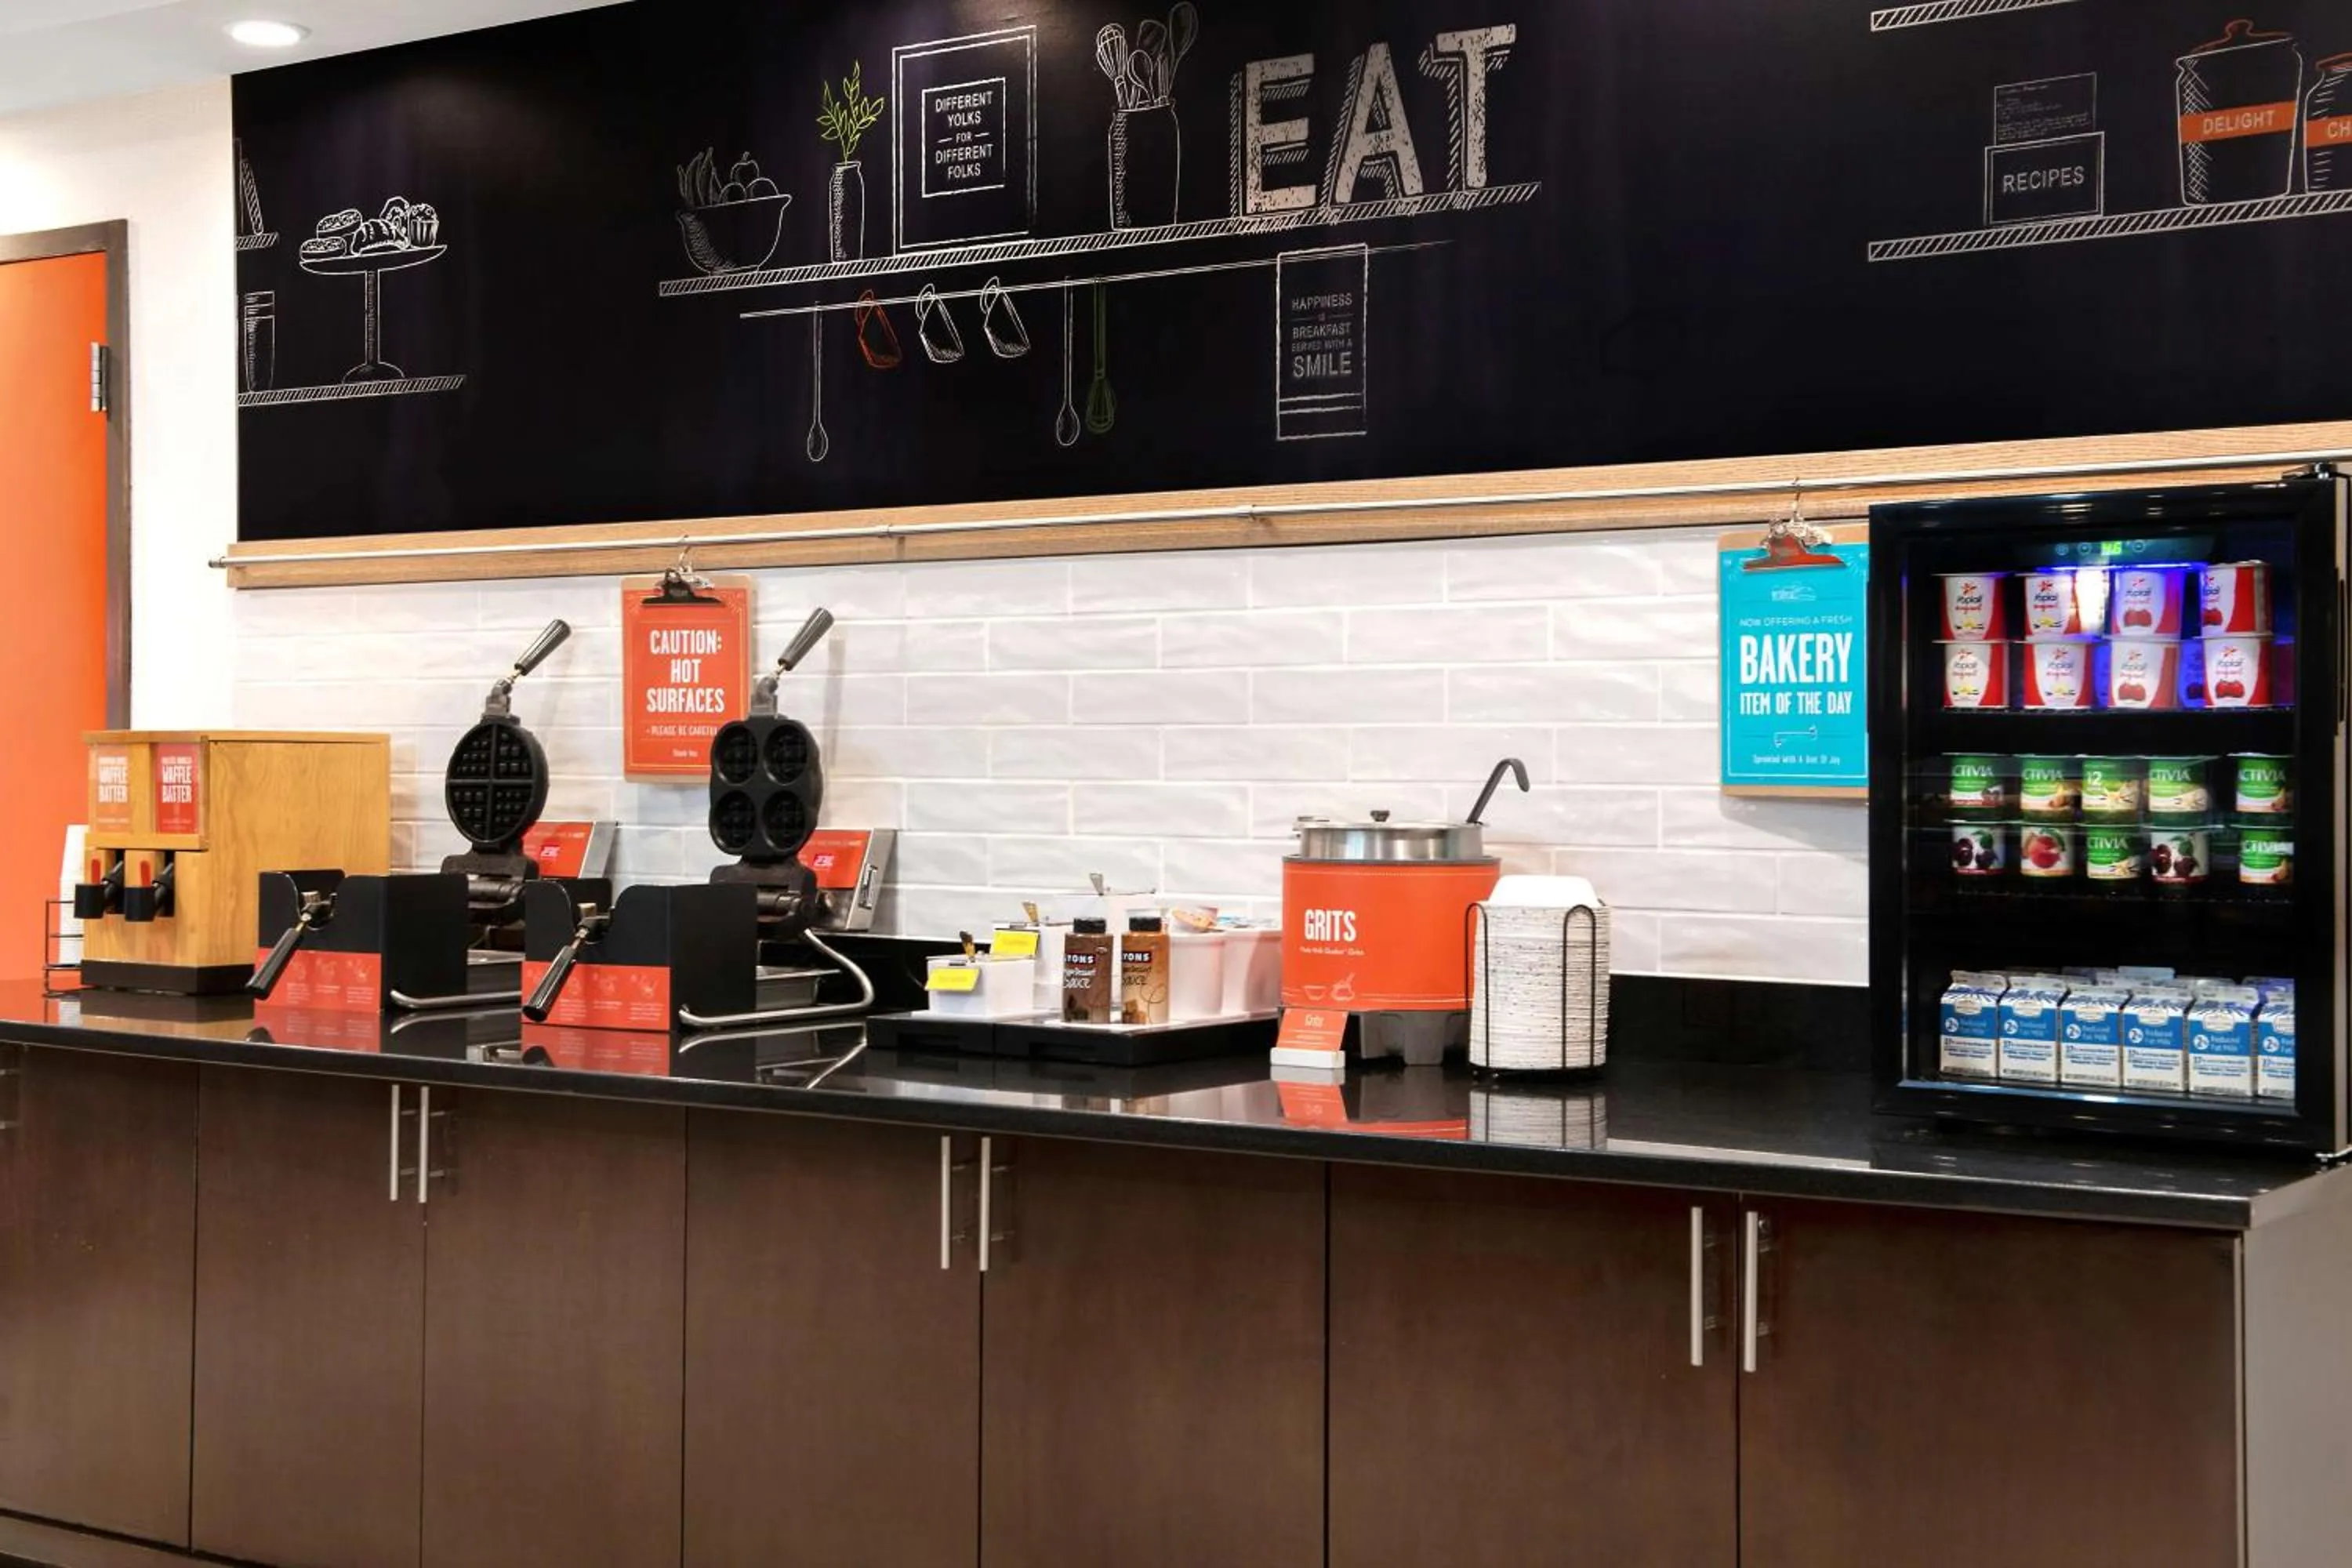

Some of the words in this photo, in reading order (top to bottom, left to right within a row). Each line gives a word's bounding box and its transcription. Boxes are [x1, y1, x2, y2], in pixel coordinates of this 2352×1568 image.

[935, 90, 993, 113] DIFFERENT
[947, 110, 982, 127] YOLKS
[1243, 23, 1517, 216] EAT
[2202, 110, 2276, 135] DELIGHT
[956, 131, 972, 143] FOR
[935, 143, 993, 164] DIFFERENT
[947, 162, 982, 180] FOLKS
[2002, 165, 2085, 194] RECIPES
[1291, 292, 1352, 311] HAPPINESS
[1292, 321, 1352, 339] BREAKFAST
[1293, 350, 1352, 378] SMILE
[1739, 618, 1762, 627] NOW
[1764, 616, 1811, 626] OFFERING
[1820, 615, 1853, 625] FRESH
[649, 628, 722, 655] CAUTION:
[1740, 632, 1853, 684] BAKERY
[670, 659, 702, 684] HOT
[646, 688, 725, 713] SURFACES
[1740, 691, 1770, 715] ITEM
[1776, 691, 1793, 715] OF
[1797, 691, 1822, 714] THE
[1828, 691, 1853, 714] DAY
[689, 725, 718, 735] CAREFU
[99, 765, 128, 784] WAFFLE
[162, 764, 193, 784] WAFFLE
[1951, 764, 1994, 777] CTIVIA
[2022, 768, 2064, 781] CTIVIA
[2149, 768, 2192, 781] CTIVIA
[99, 785, 128, 803] BATTER
[162, 785, 193, 804] BATTER
[2087, 836, 2129, 850] CTIVIA
[1305, 909, 1356, 942] GRITS
[1064, 955, 1094, 964] YONS
